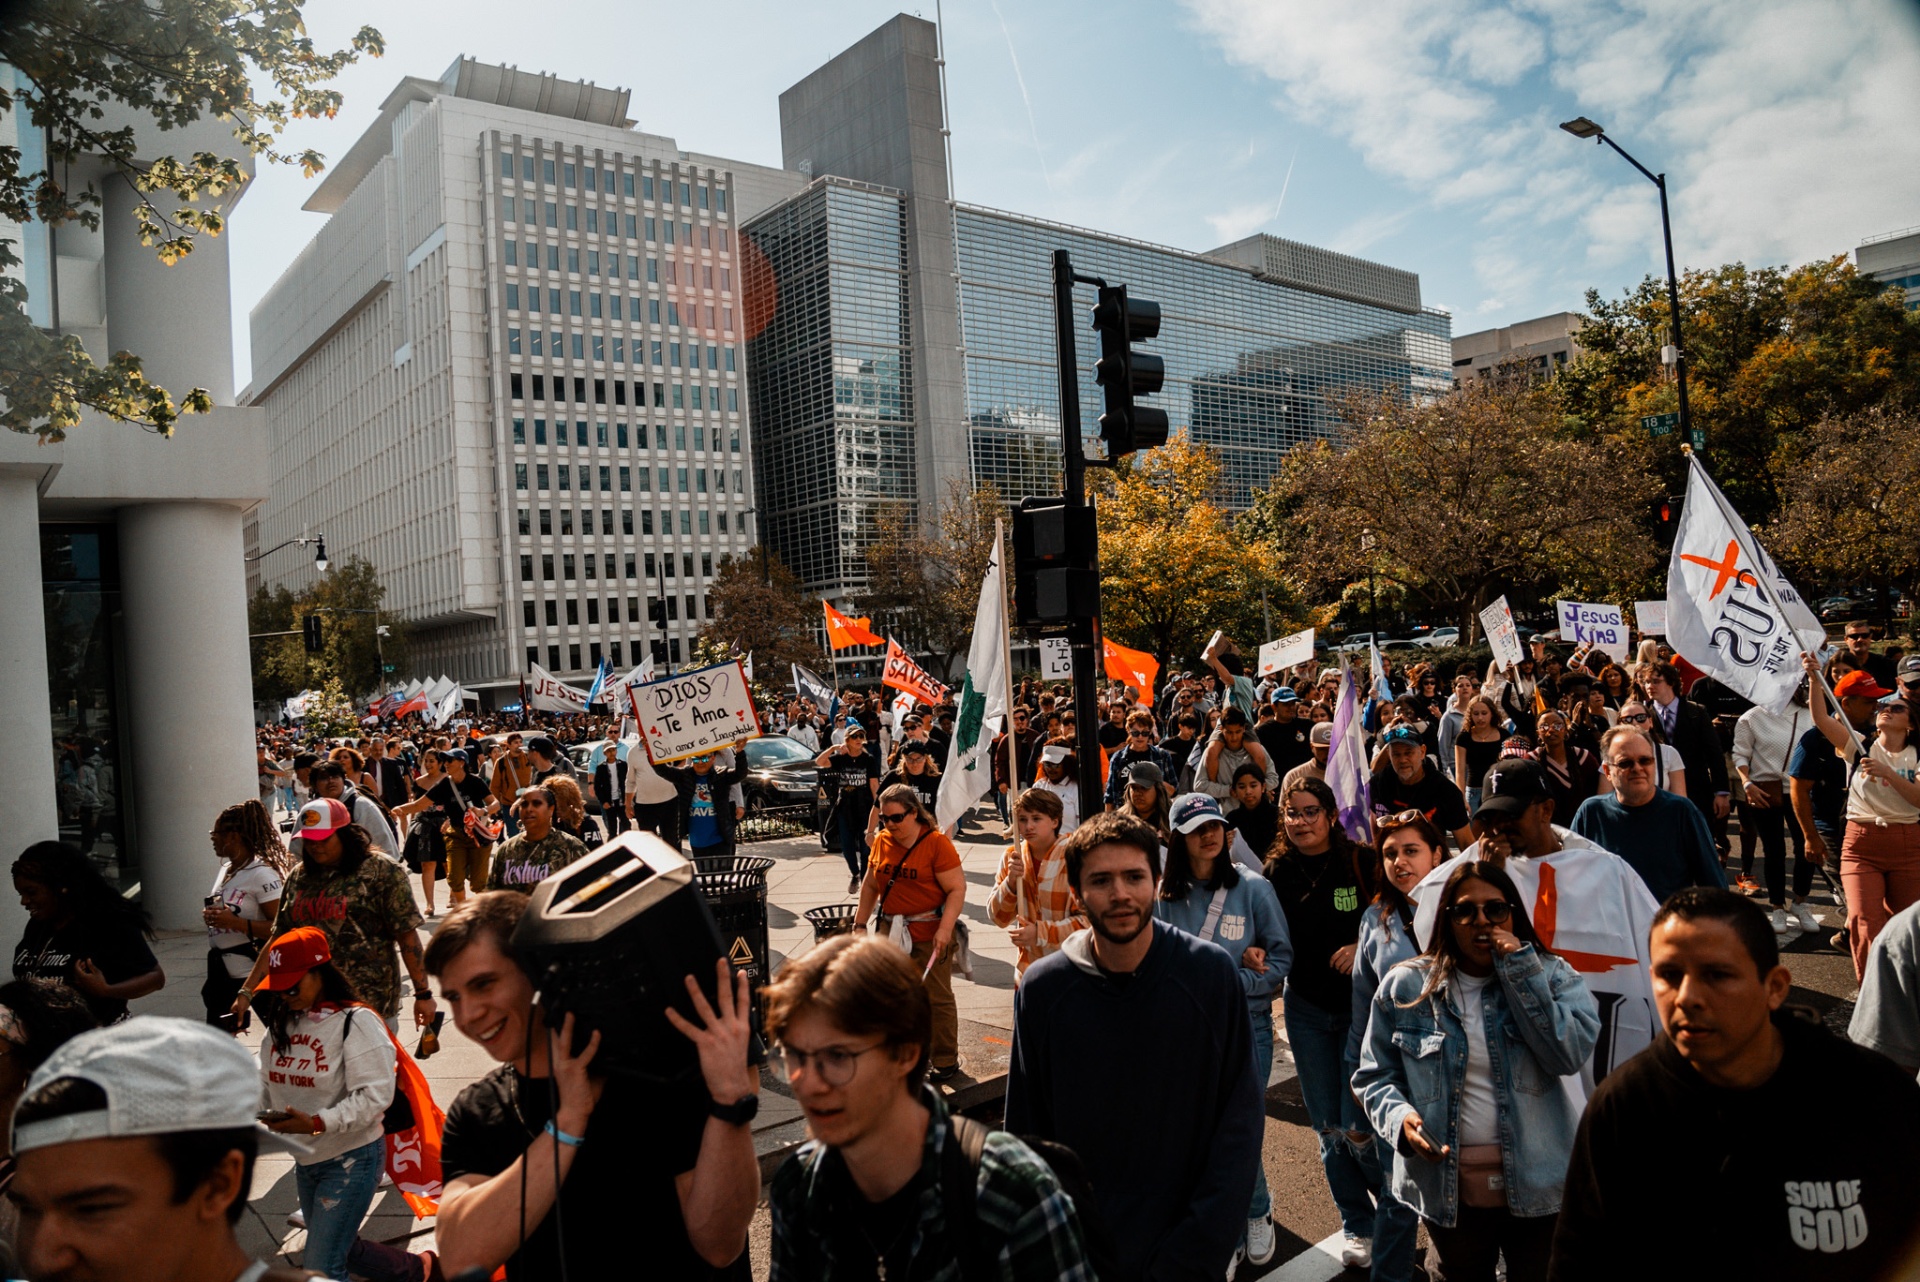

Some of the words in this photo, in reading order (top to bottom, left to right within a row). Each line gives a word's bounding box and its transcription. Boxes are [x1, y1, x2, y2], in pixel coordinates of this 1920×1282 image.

[1644, 416, 1658, 428] 18
[1654, 426, 1669, 434] 700
[1693, 432, 1698, 441] H
[1564, 603, 1620, 626] Jesus
[1272, 633, 1303, 651] JESUS
[1574, 622, 1618, 644] King
[1047, 639, 1070, 648] JES
[1051, 661, 1072, 673] LO
[888, 658, 942, 698] SAVES
[655, 676, 711, 708] DIOS
[657, 713, 682, 733] Te
[692, 706, 729, 726] Ama
[653, 740, 672, 758] Su
[676, 740, 696, 752] amor
[699, 737, 709, 745] es
[710, 724, 756, 744] Inagotable
[1334, 887, 1348, 897] SON
[1348, 886, 1357, 896] OF
[1334, 894, 1358, 912] GOD
[1222, 914, 1237, 924] SON
[1236, 915, 1246, 925] OF
[1219, 923, 1245, 941] GOD
[275, 1056, 296, 1069] EST
[297, 1058, 312, 1071] 77
[269, 1070, 287, 1085] NEW
[288, 1074, 316, 1088] YORK
[1784, 1180, 1835, 1209] SON
[1835, 1179, 1862, 1208] OF
[1787, 1203, 1869, 1254] GOD
